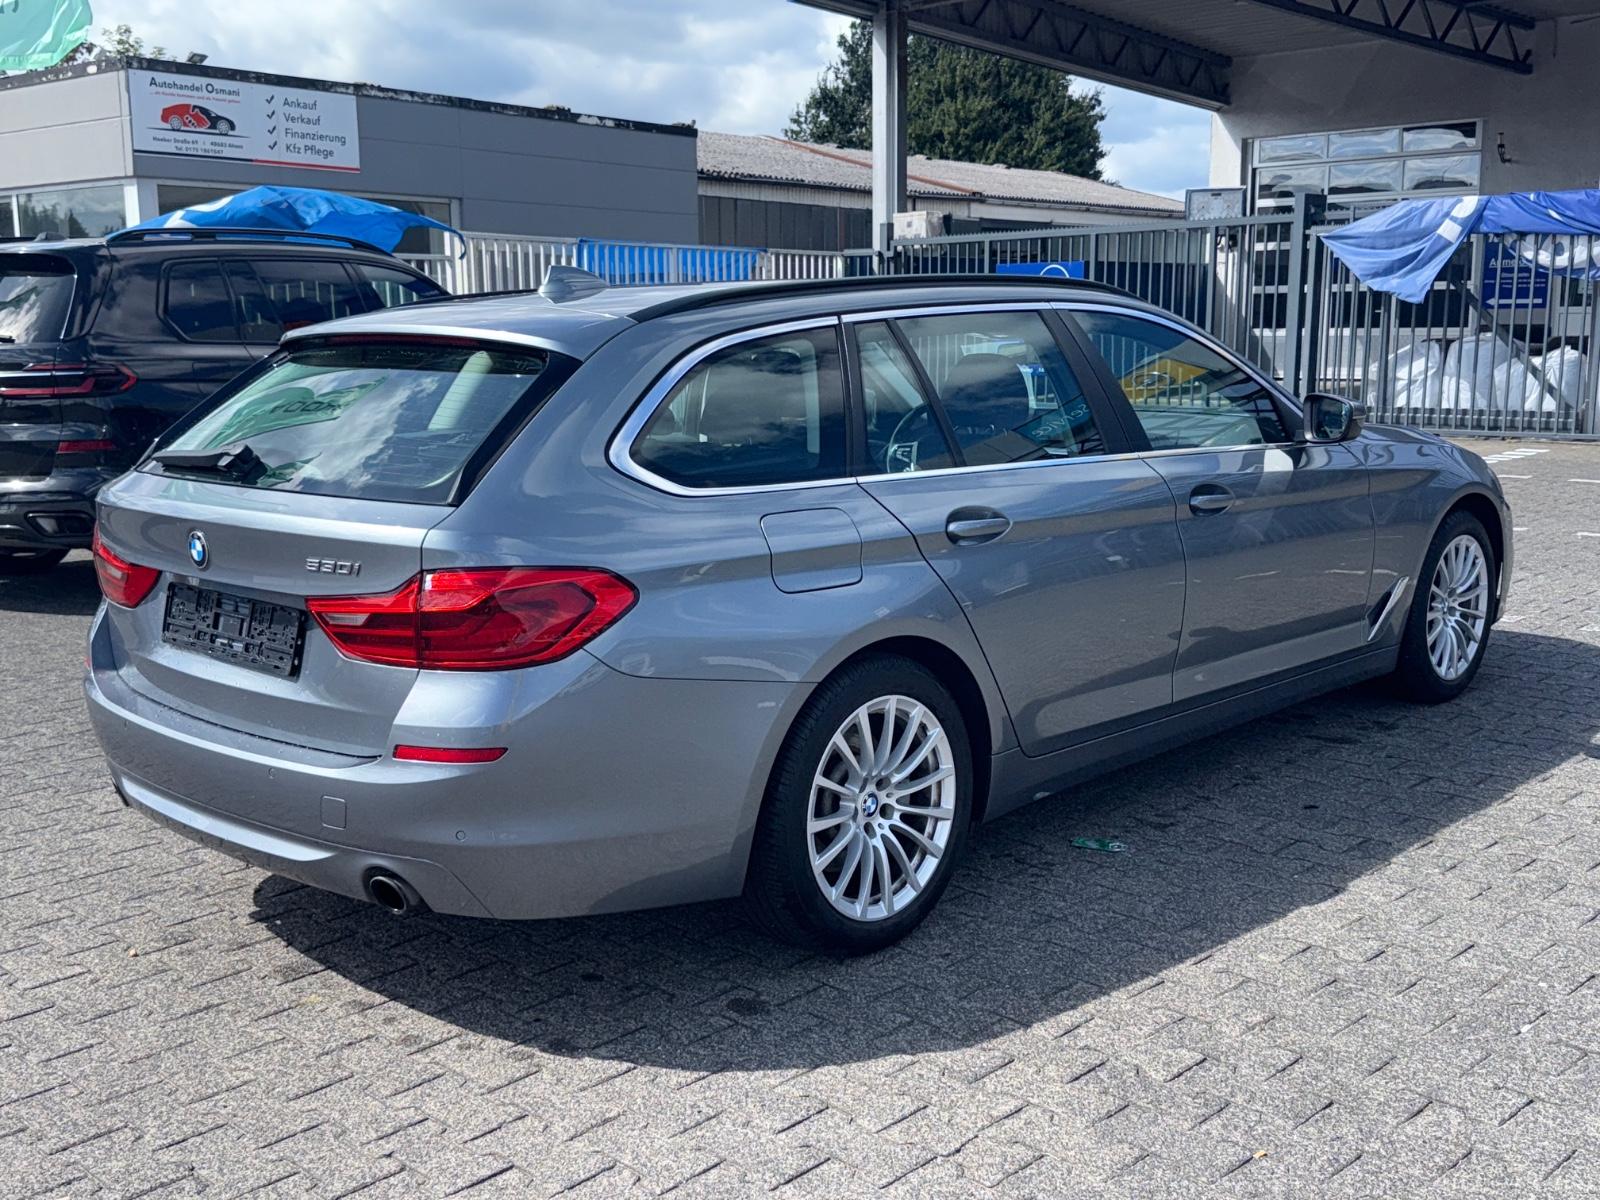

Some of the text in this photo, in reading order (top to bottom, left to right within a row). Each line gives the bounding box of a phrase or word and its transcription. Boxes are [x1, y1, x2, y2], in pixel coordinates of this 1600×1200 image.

[149, 76, 203, 93] Autohandel
[205, 83, 241, 97] Osmani
[282, 97, 317, 111] Ankauf
[283, 112, 321, 126] Verkauf
[285, 128, 346, 147] Finanzierung
[285, 143, 335, 160] Kfz Pflege
[304, 558, 361, 577] 530i
